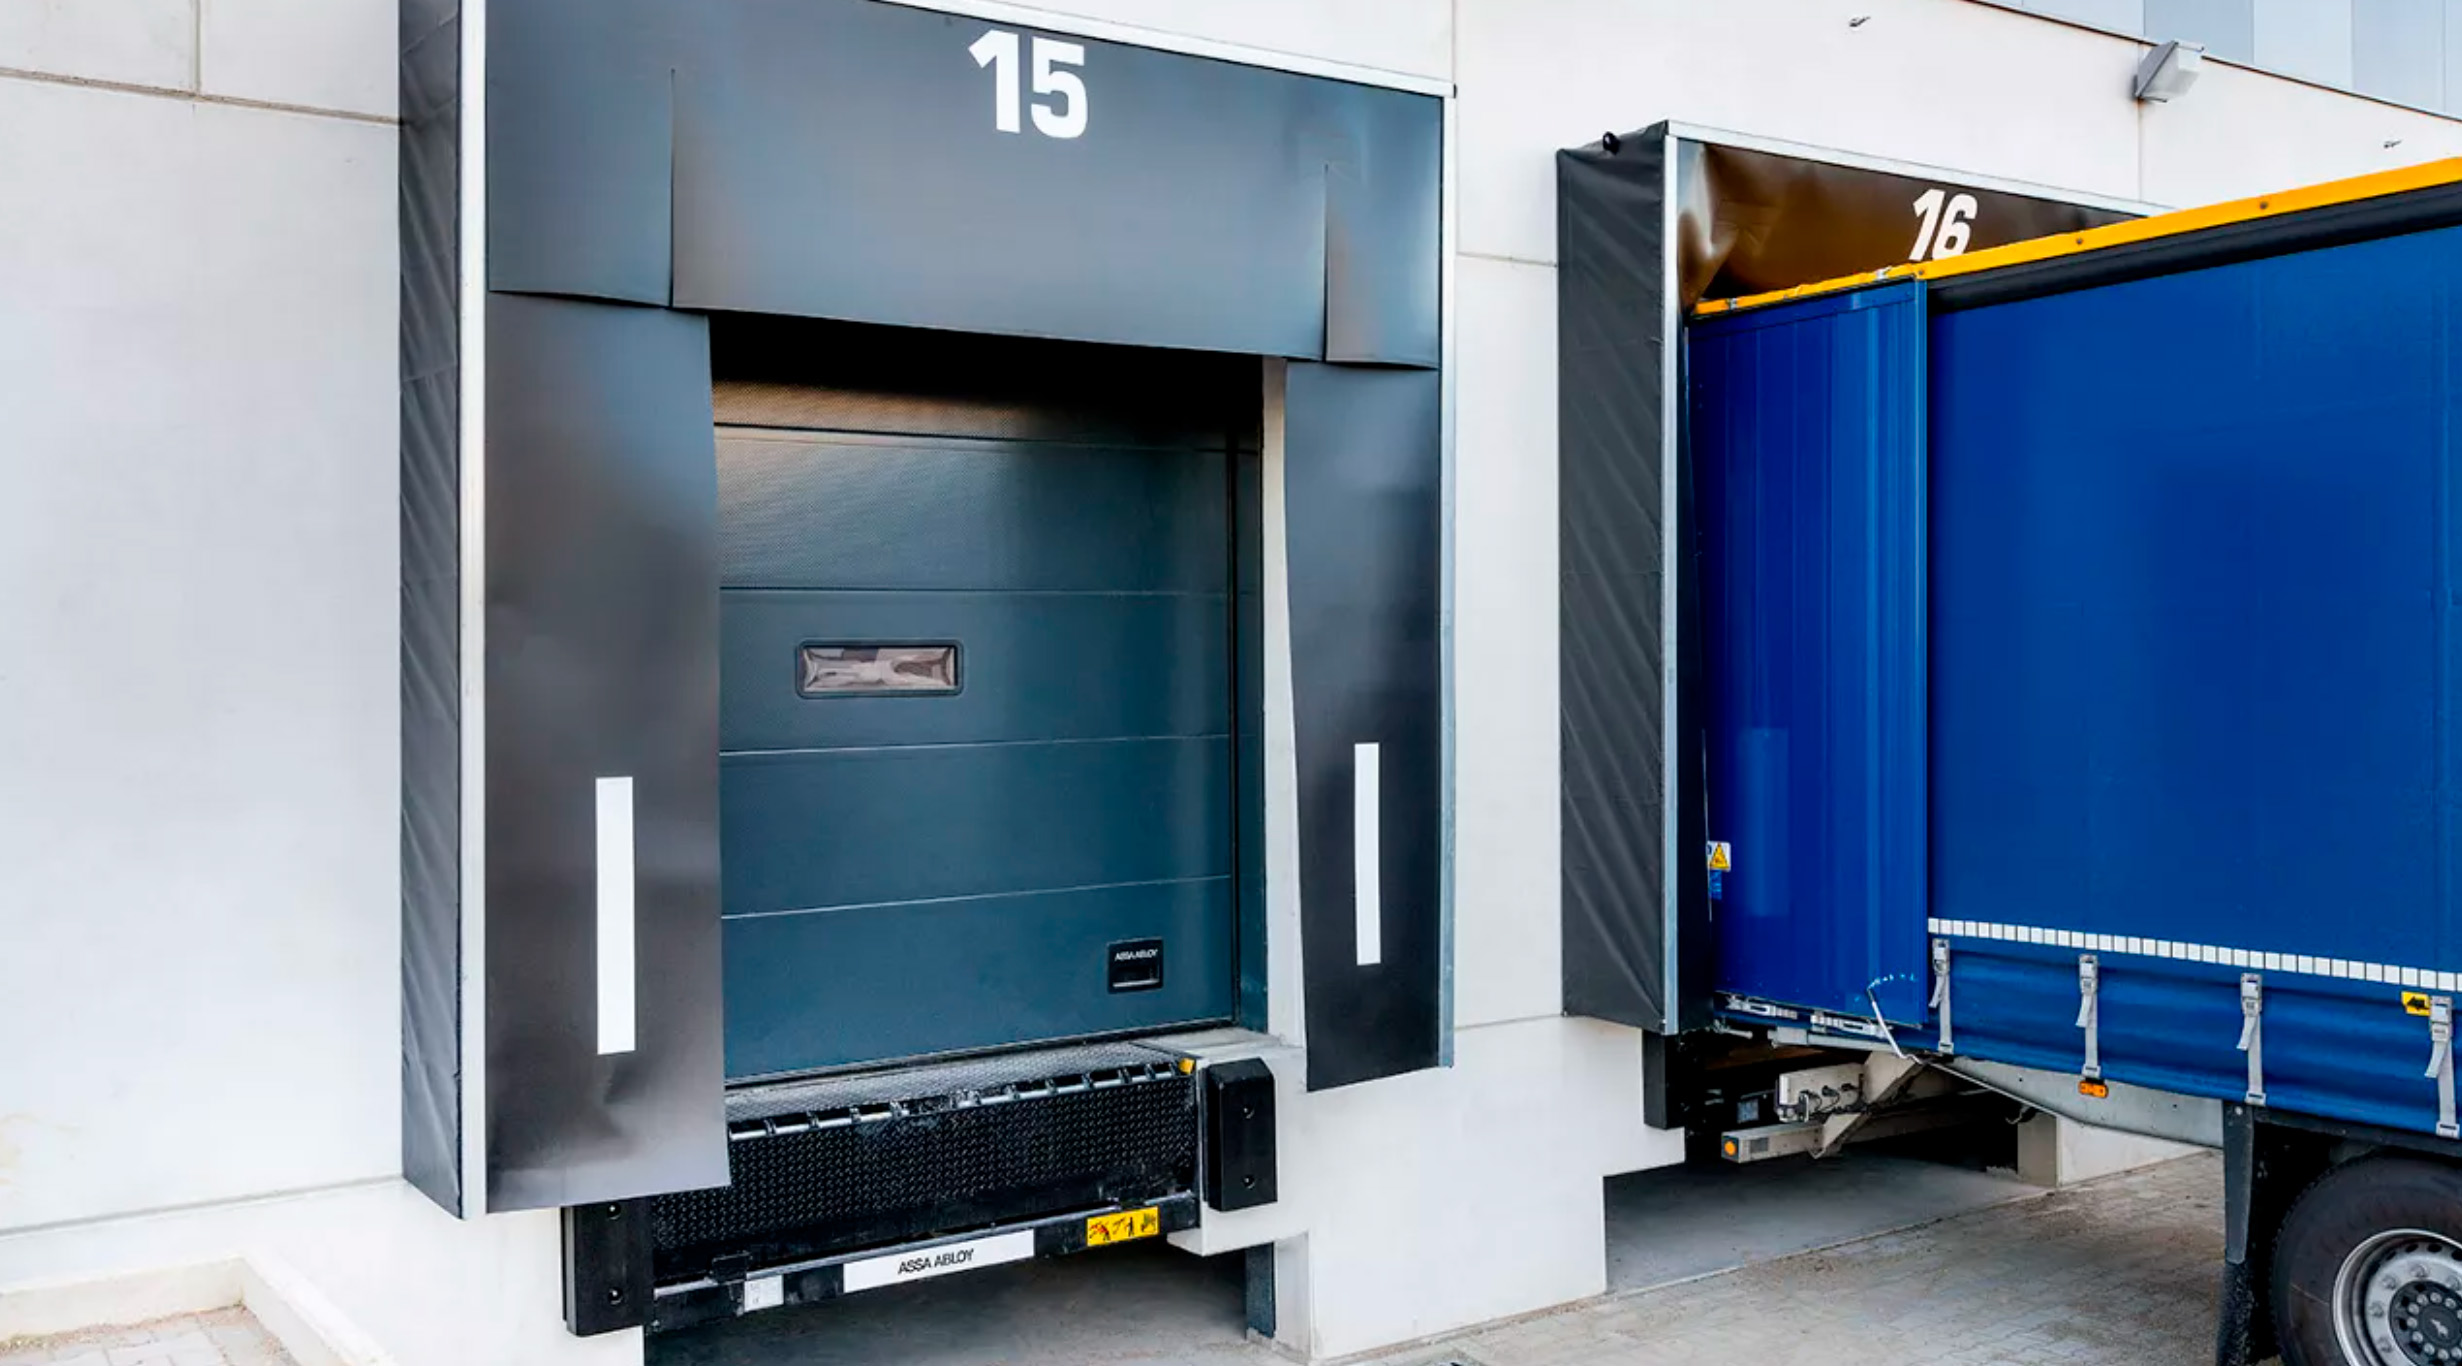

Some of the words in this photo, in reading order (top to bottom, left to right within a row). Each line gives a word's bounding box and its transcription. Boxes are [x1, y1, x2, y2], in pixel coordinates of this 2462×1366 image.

[967, 28, 1088, 139] 15
[1908, 188, 1978, 262] 16
[898, 1257, 931, 1274] ASSA
[934, 1248, 974, 1267] ABLOY
